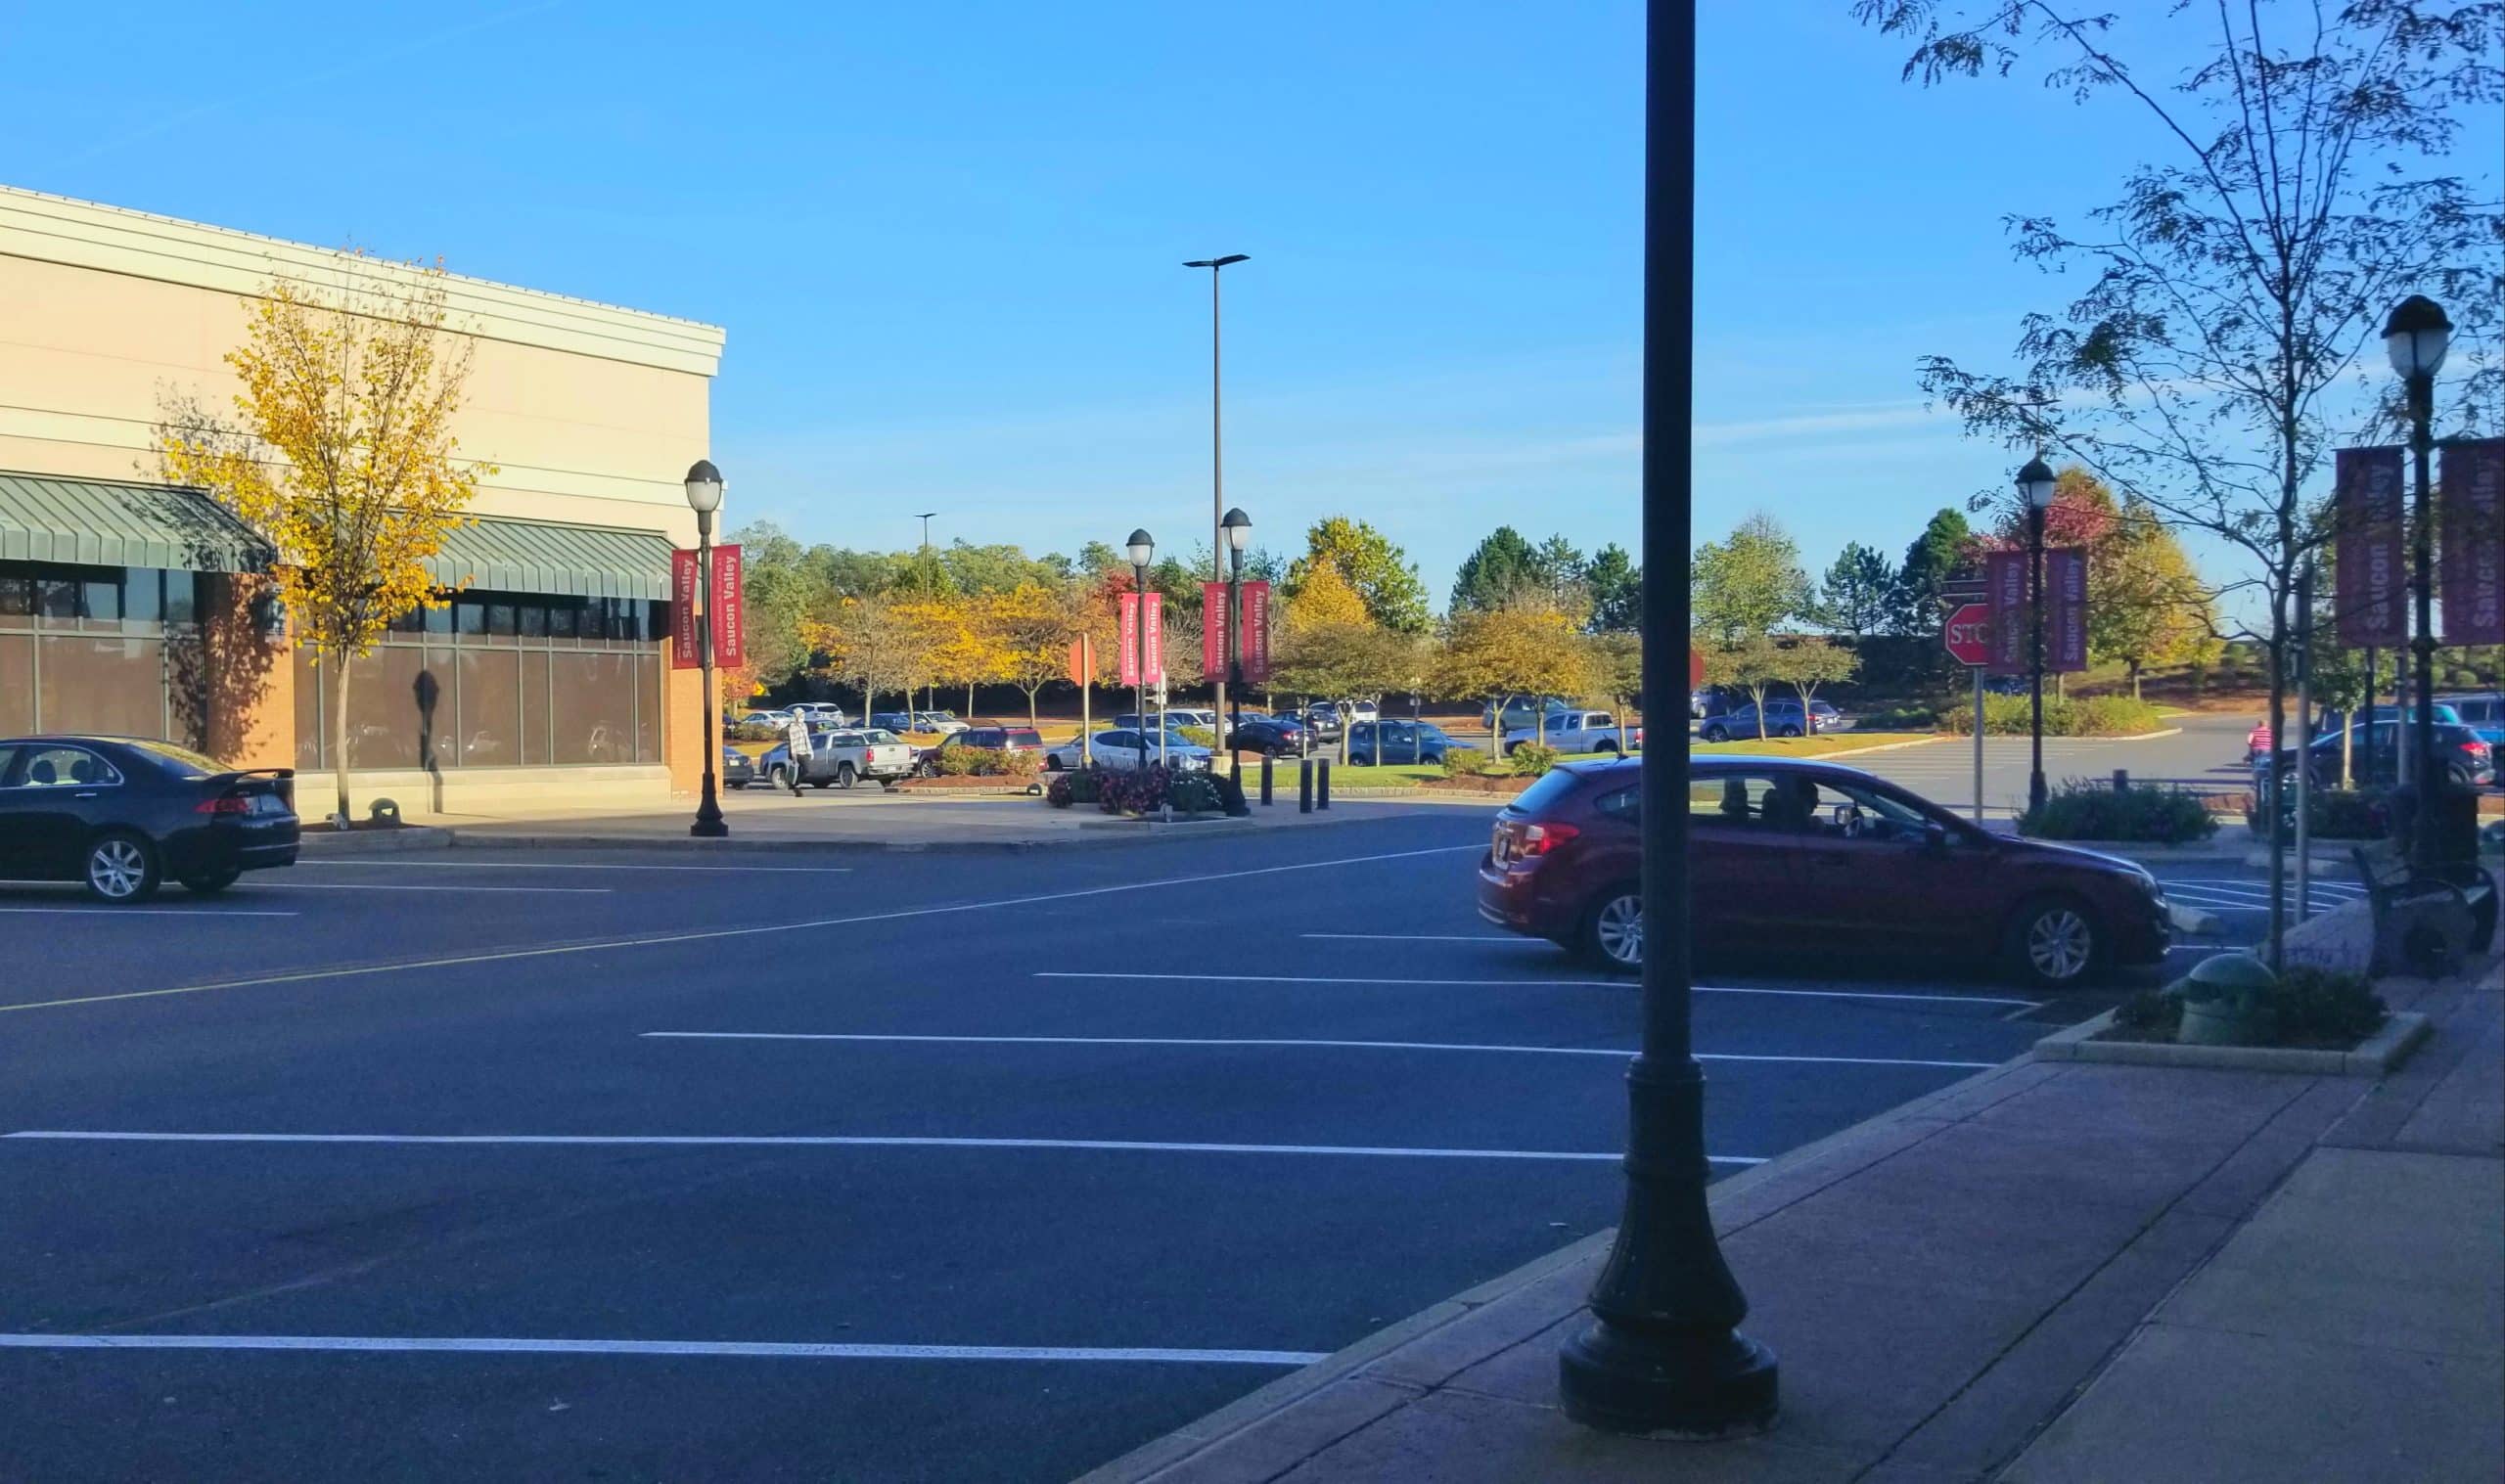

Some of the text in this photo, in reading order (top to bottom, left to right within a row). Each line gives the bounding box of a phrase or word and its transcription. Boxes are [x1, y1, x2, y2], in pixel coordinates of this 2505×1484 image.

[681, 559, 693, 657] Saucon Valley
[724, 556, 737, 656] Saucon Valley
[1150, 602, 1159, 634] Valley
[2004, 562, 2021, 663] Sauc Valley
[2065, 559, 2081, 661] Saucon Valley
[2366, 544, 2389, 630] Saucon
[2471, 540, 2496, 627] Sauc
[1215, 591, 1226, 673] Saucon Valley
[1253, 590, 1265, 673] Saucon Valley
[1950, 623, 1988, 644] STO
